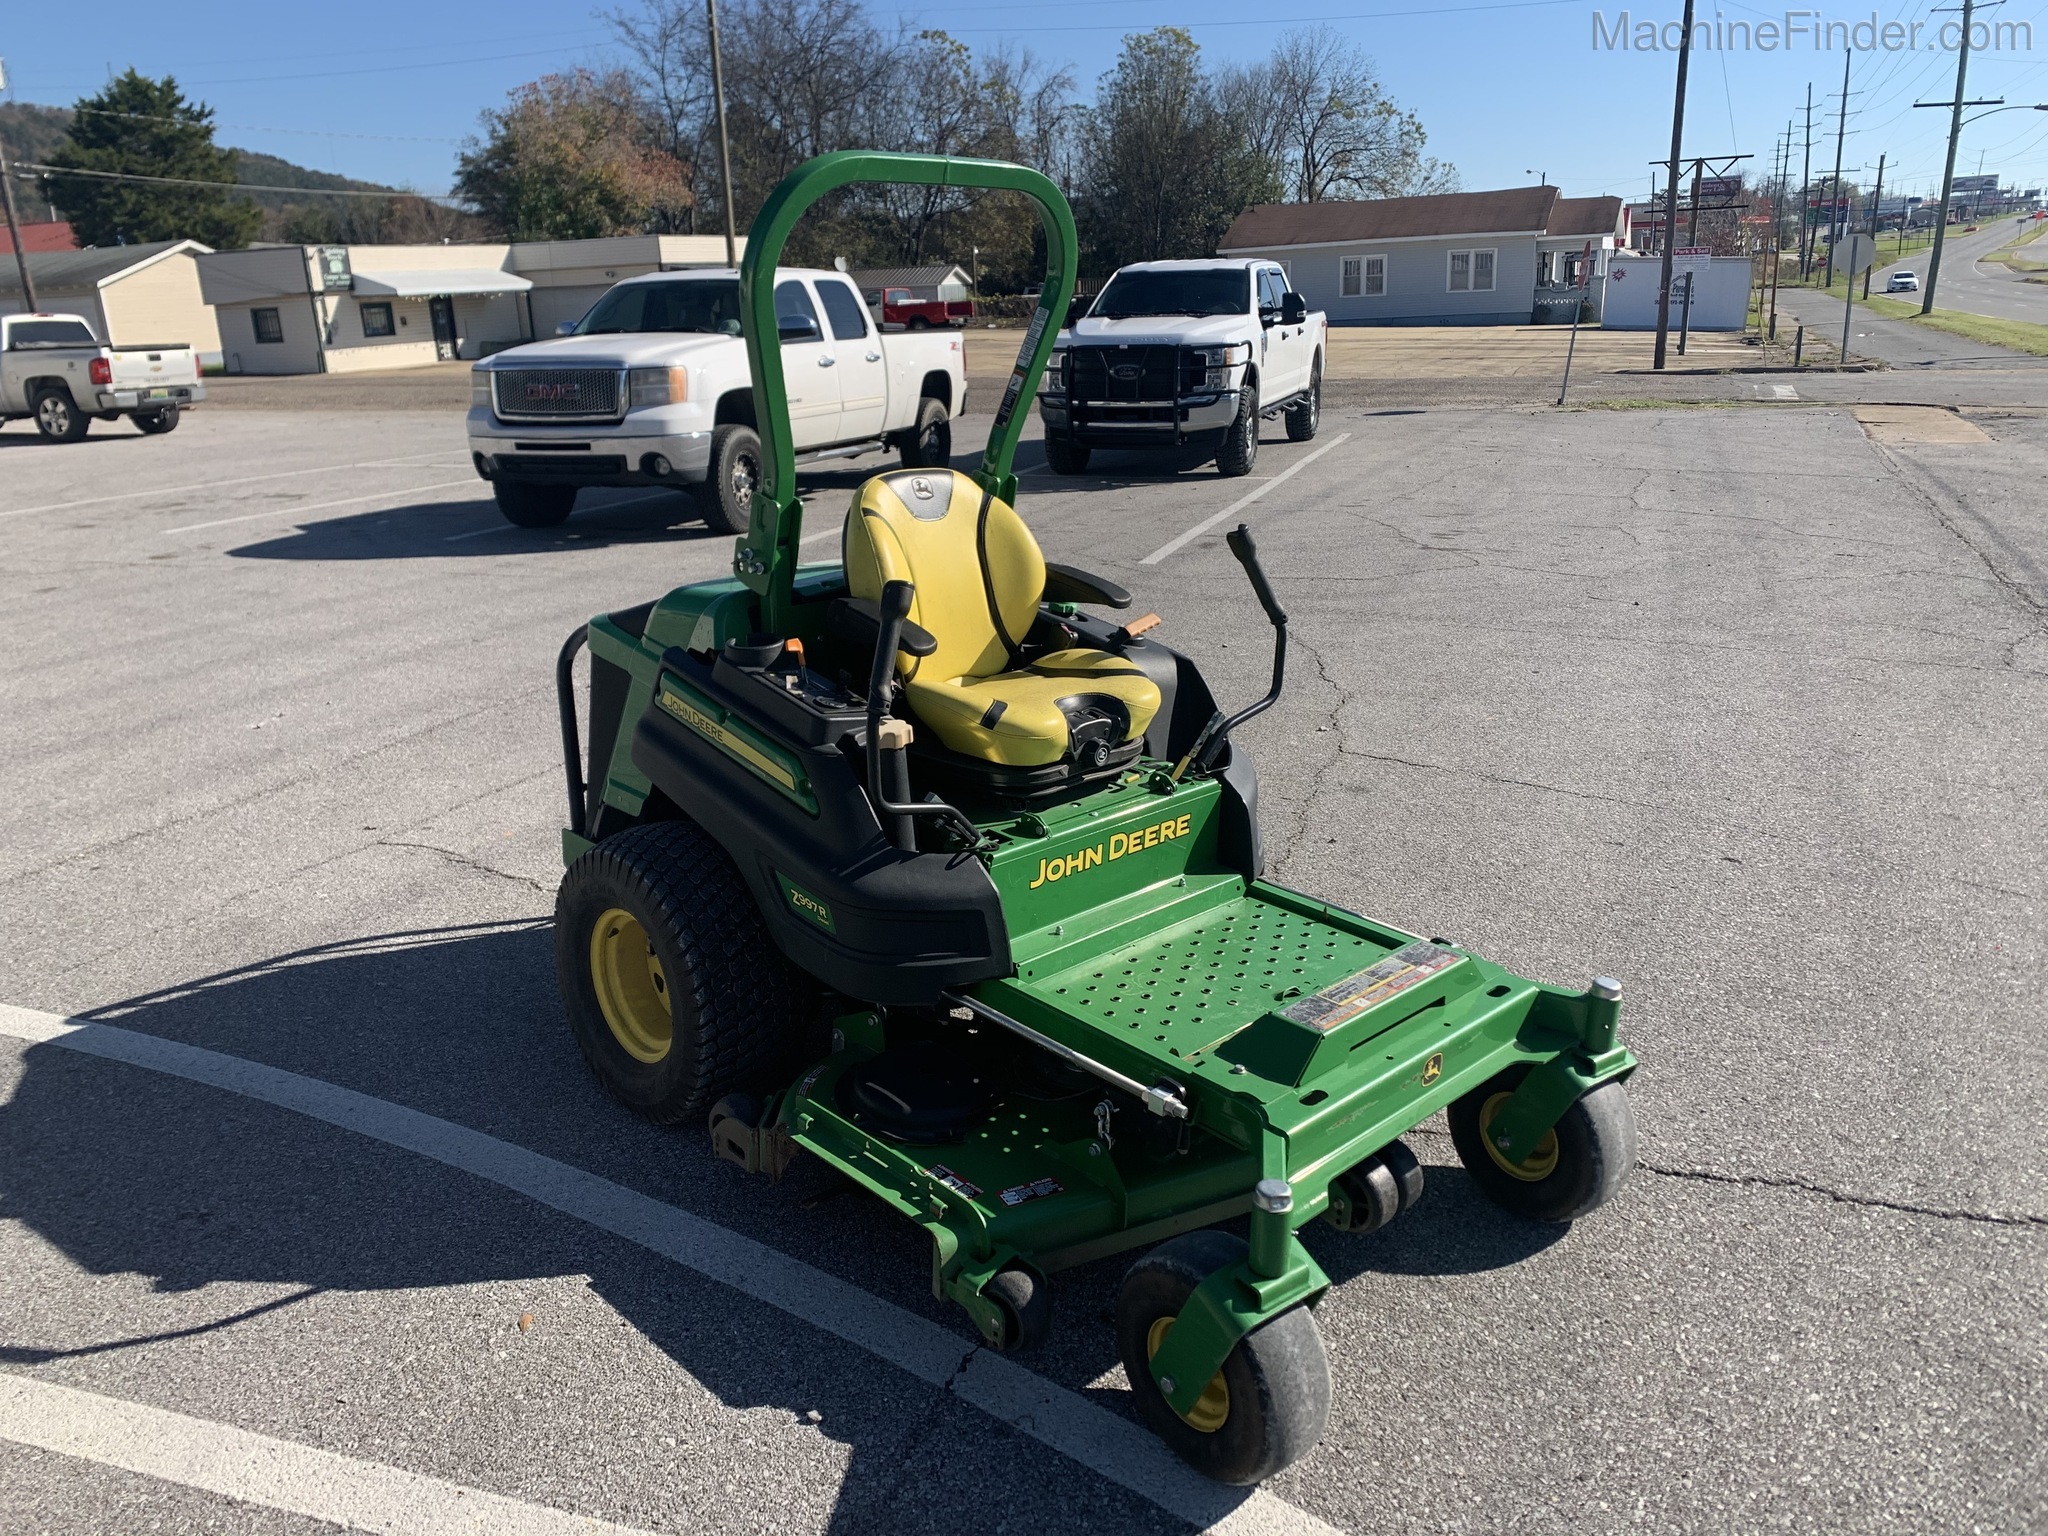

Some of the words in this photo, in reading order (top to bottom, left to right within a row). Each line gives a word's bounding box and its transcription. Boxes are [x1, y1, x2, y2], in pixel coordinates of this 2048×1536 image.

[525, 384, 577, 398] GMC
[667, 696, 691, 721] JOHN
[693, 712, 724, 742] DEERE
[1029, 843, 1104, 890] JOHN
[1108, 813, 1192, 861] DEERE
